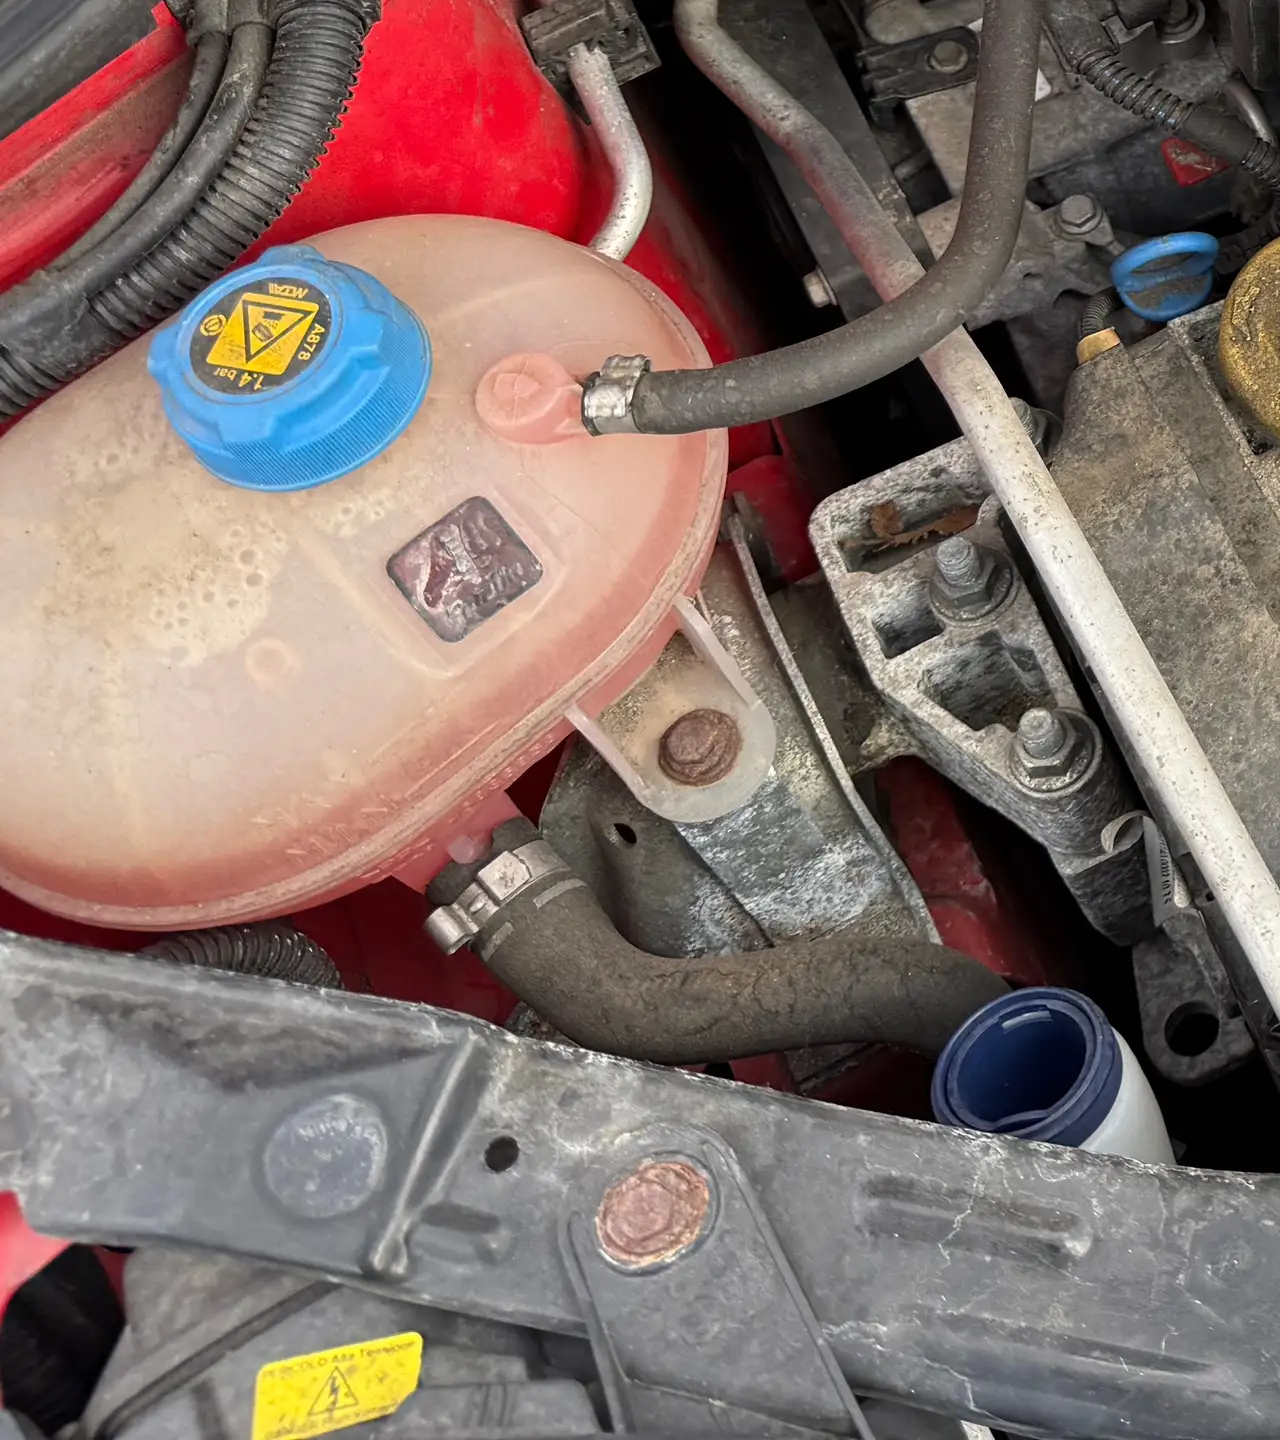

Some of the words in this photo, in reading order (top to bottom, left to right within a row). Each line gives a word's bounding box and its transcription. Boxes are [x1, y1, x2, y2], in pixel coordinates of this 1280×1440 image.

[296, 322, 327, 363] A878
[211, 366, 238, 382] bar
[237, 372, 265, 391] 1.4
